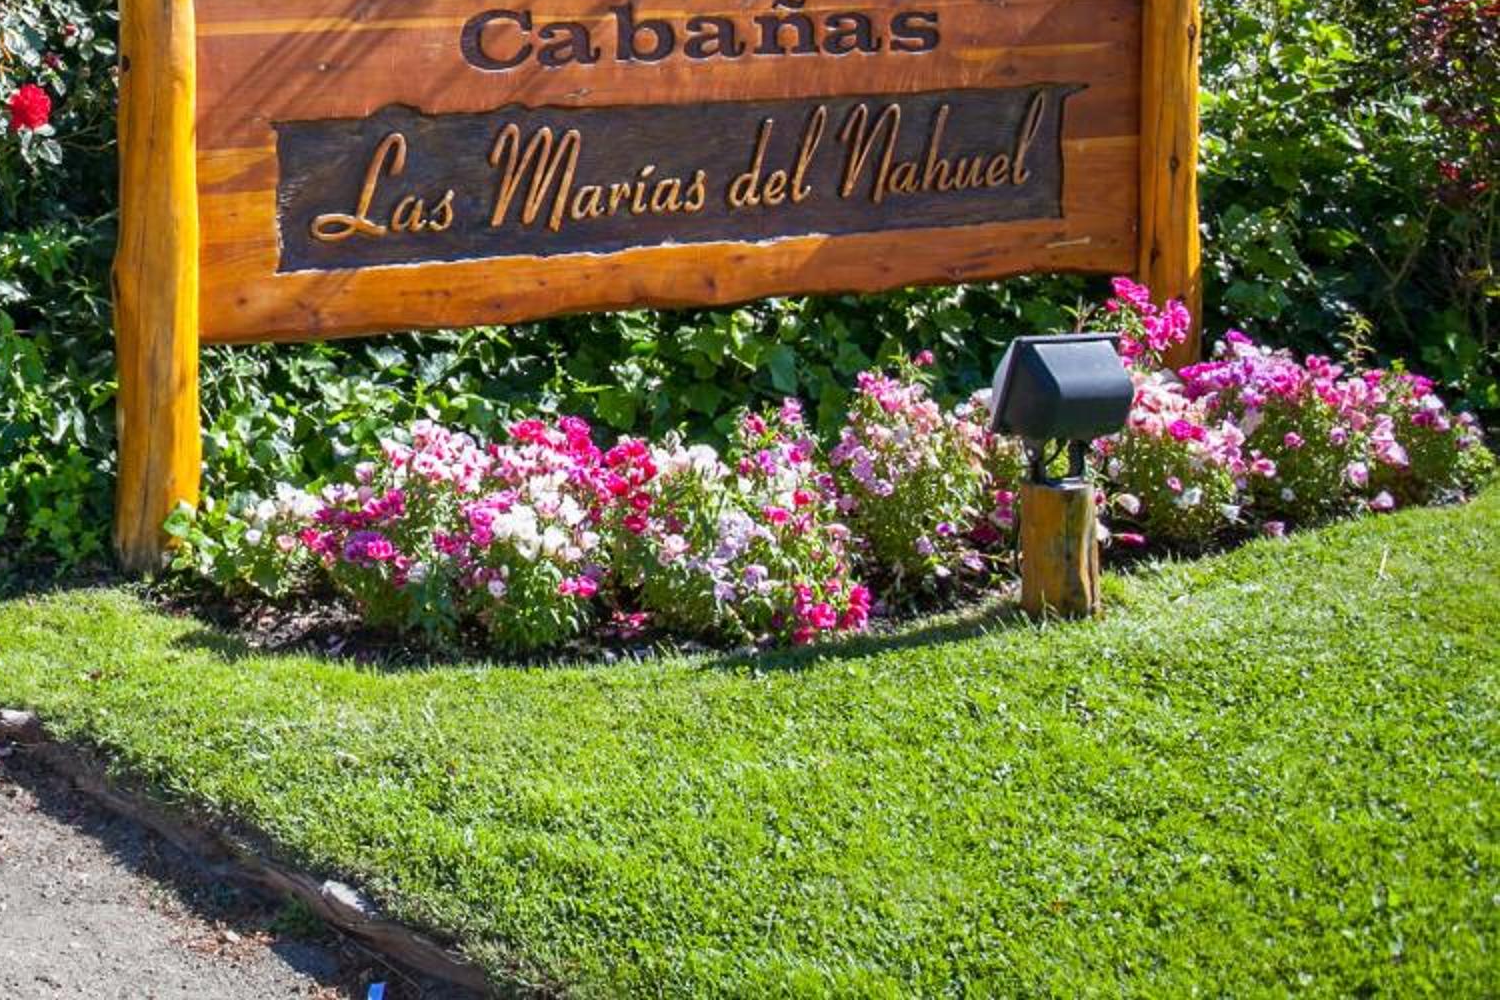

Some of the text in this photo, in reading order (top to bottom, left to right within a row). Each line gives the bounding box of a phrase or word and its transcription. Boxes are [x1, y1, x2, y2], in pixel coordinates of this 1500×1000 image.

[311, 91, 1046, 241] Las Marías del Nahuel
